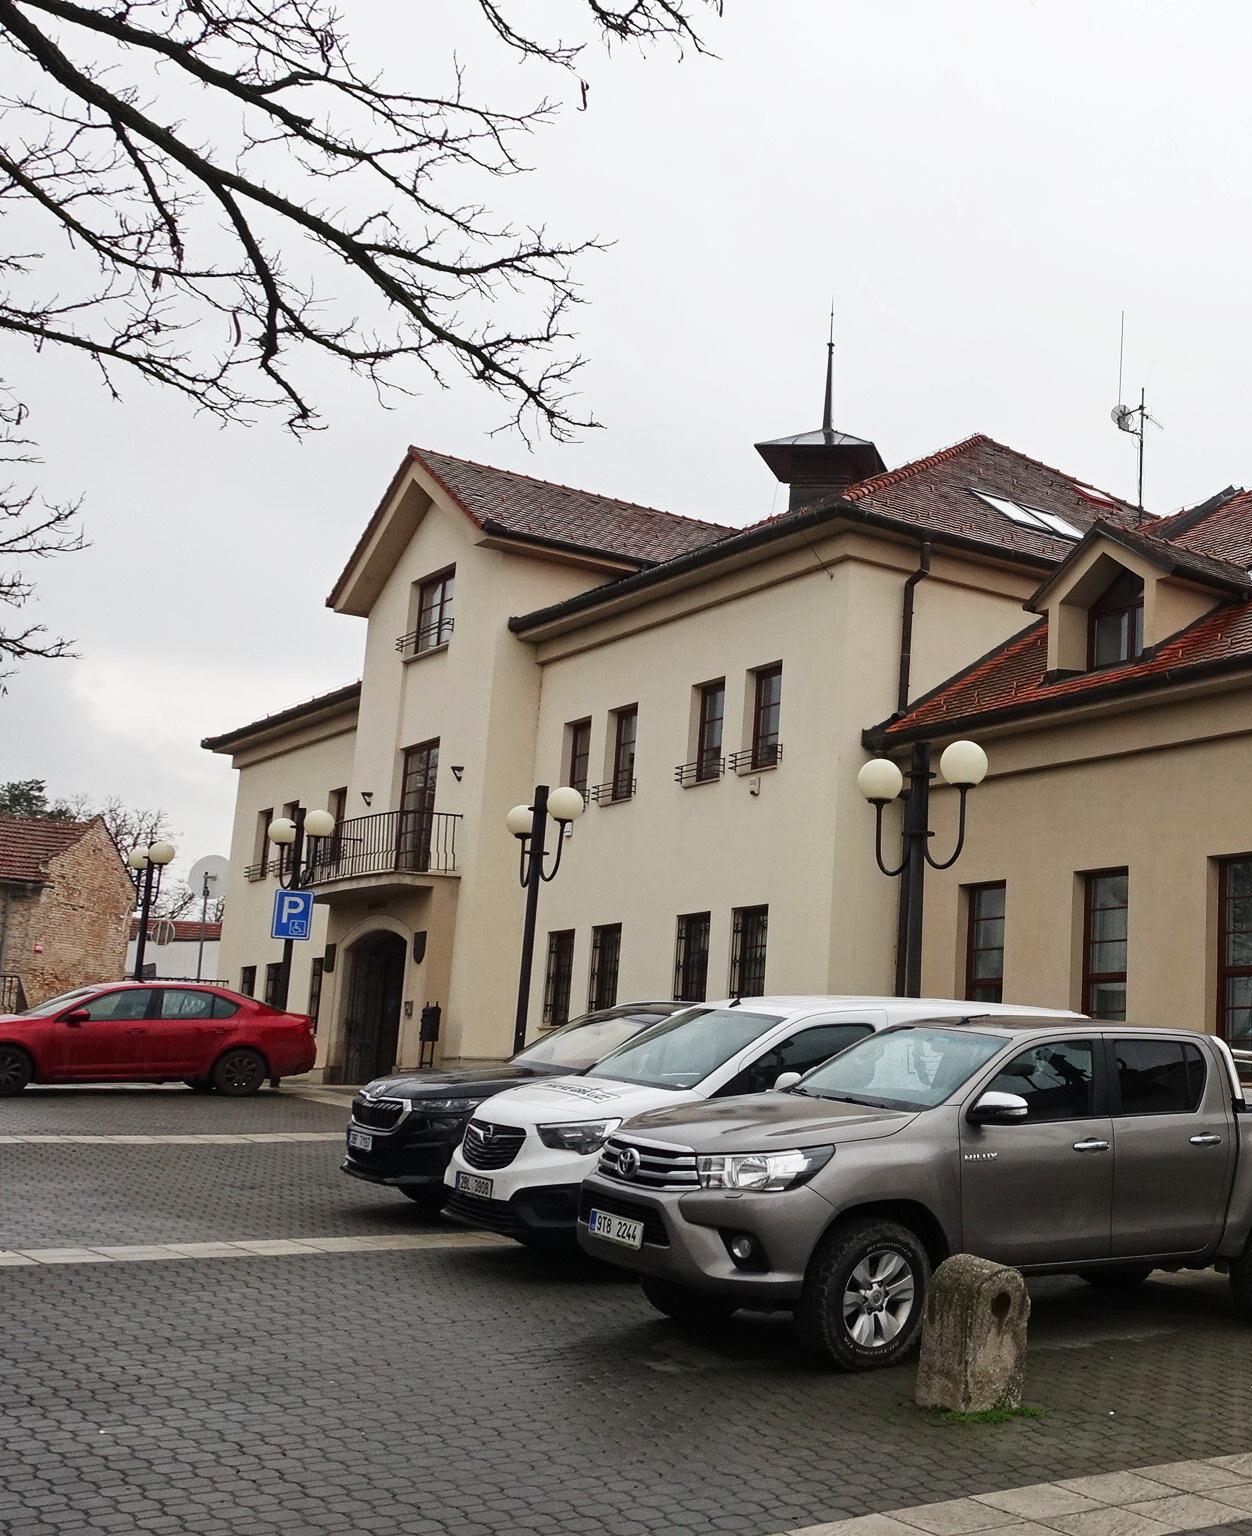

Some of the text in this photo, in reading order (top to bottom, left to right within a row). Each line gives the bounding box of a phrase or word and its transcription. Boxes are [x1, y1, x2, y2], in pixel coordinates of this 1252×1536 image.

[282, 896, 305, 923] P
[597, 1215, 638, 1242] 9T8 2244
